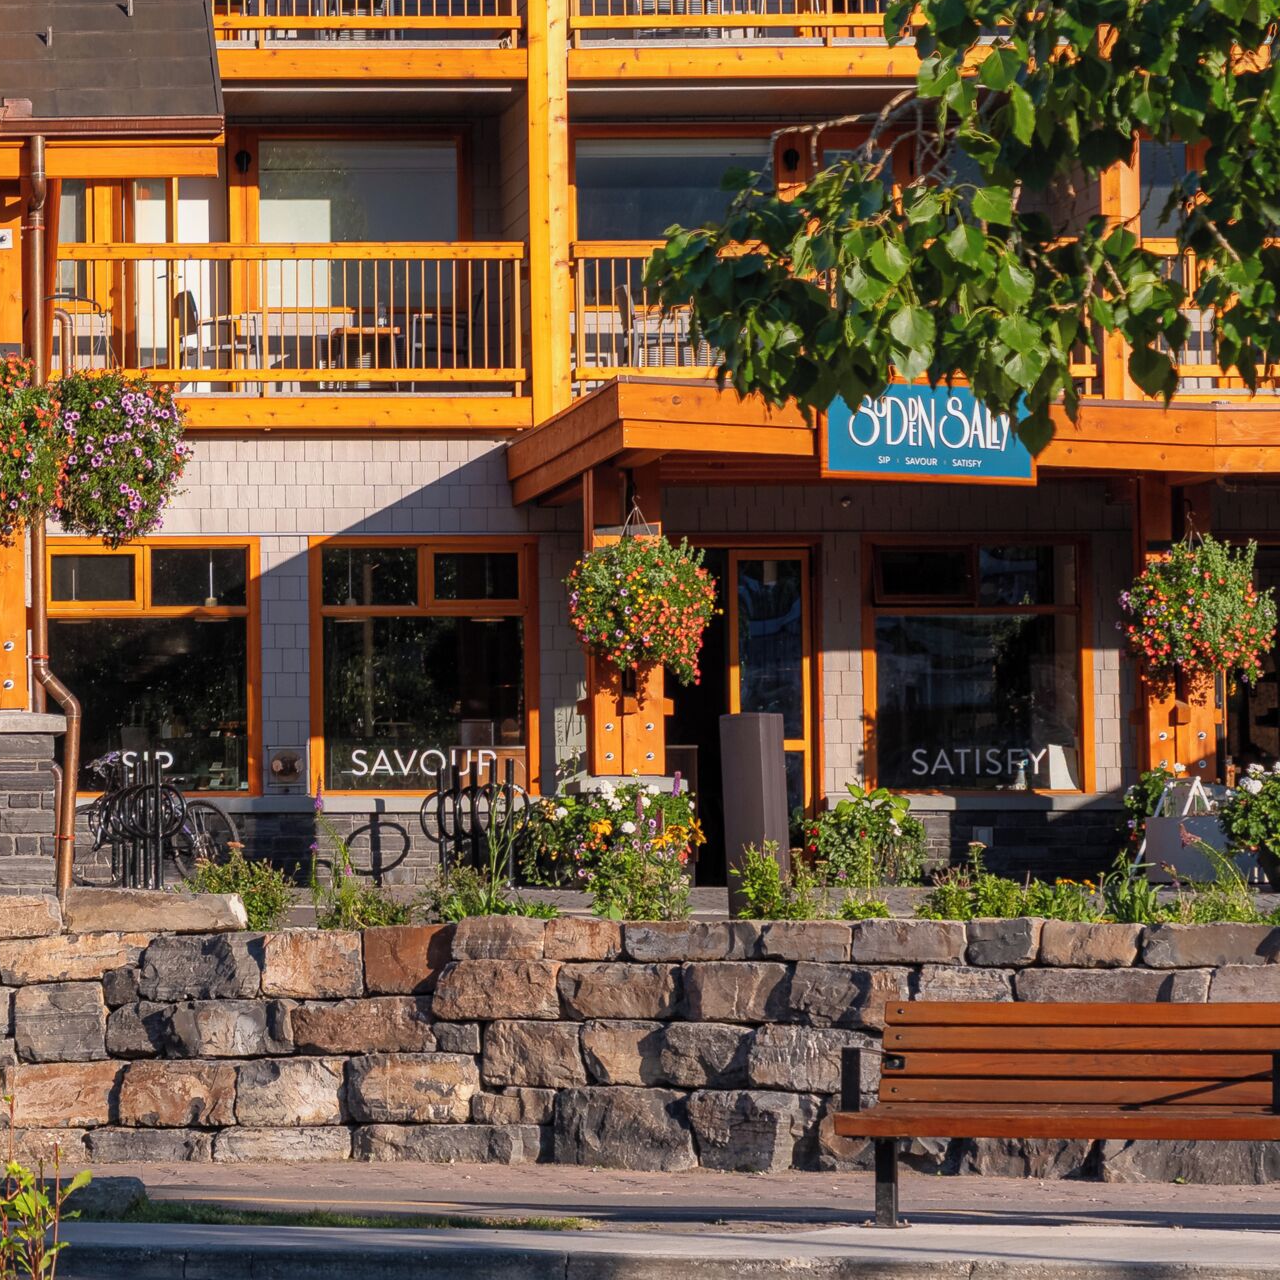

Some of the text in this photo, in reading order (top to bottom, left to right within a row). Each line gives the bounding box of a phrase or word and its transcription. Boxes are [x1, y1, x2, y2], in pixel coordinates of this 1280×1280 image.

[878, 455, 983, 468] SIP SAVOUR SATISFY
[912, 748, 1047, 775] SATISFY
